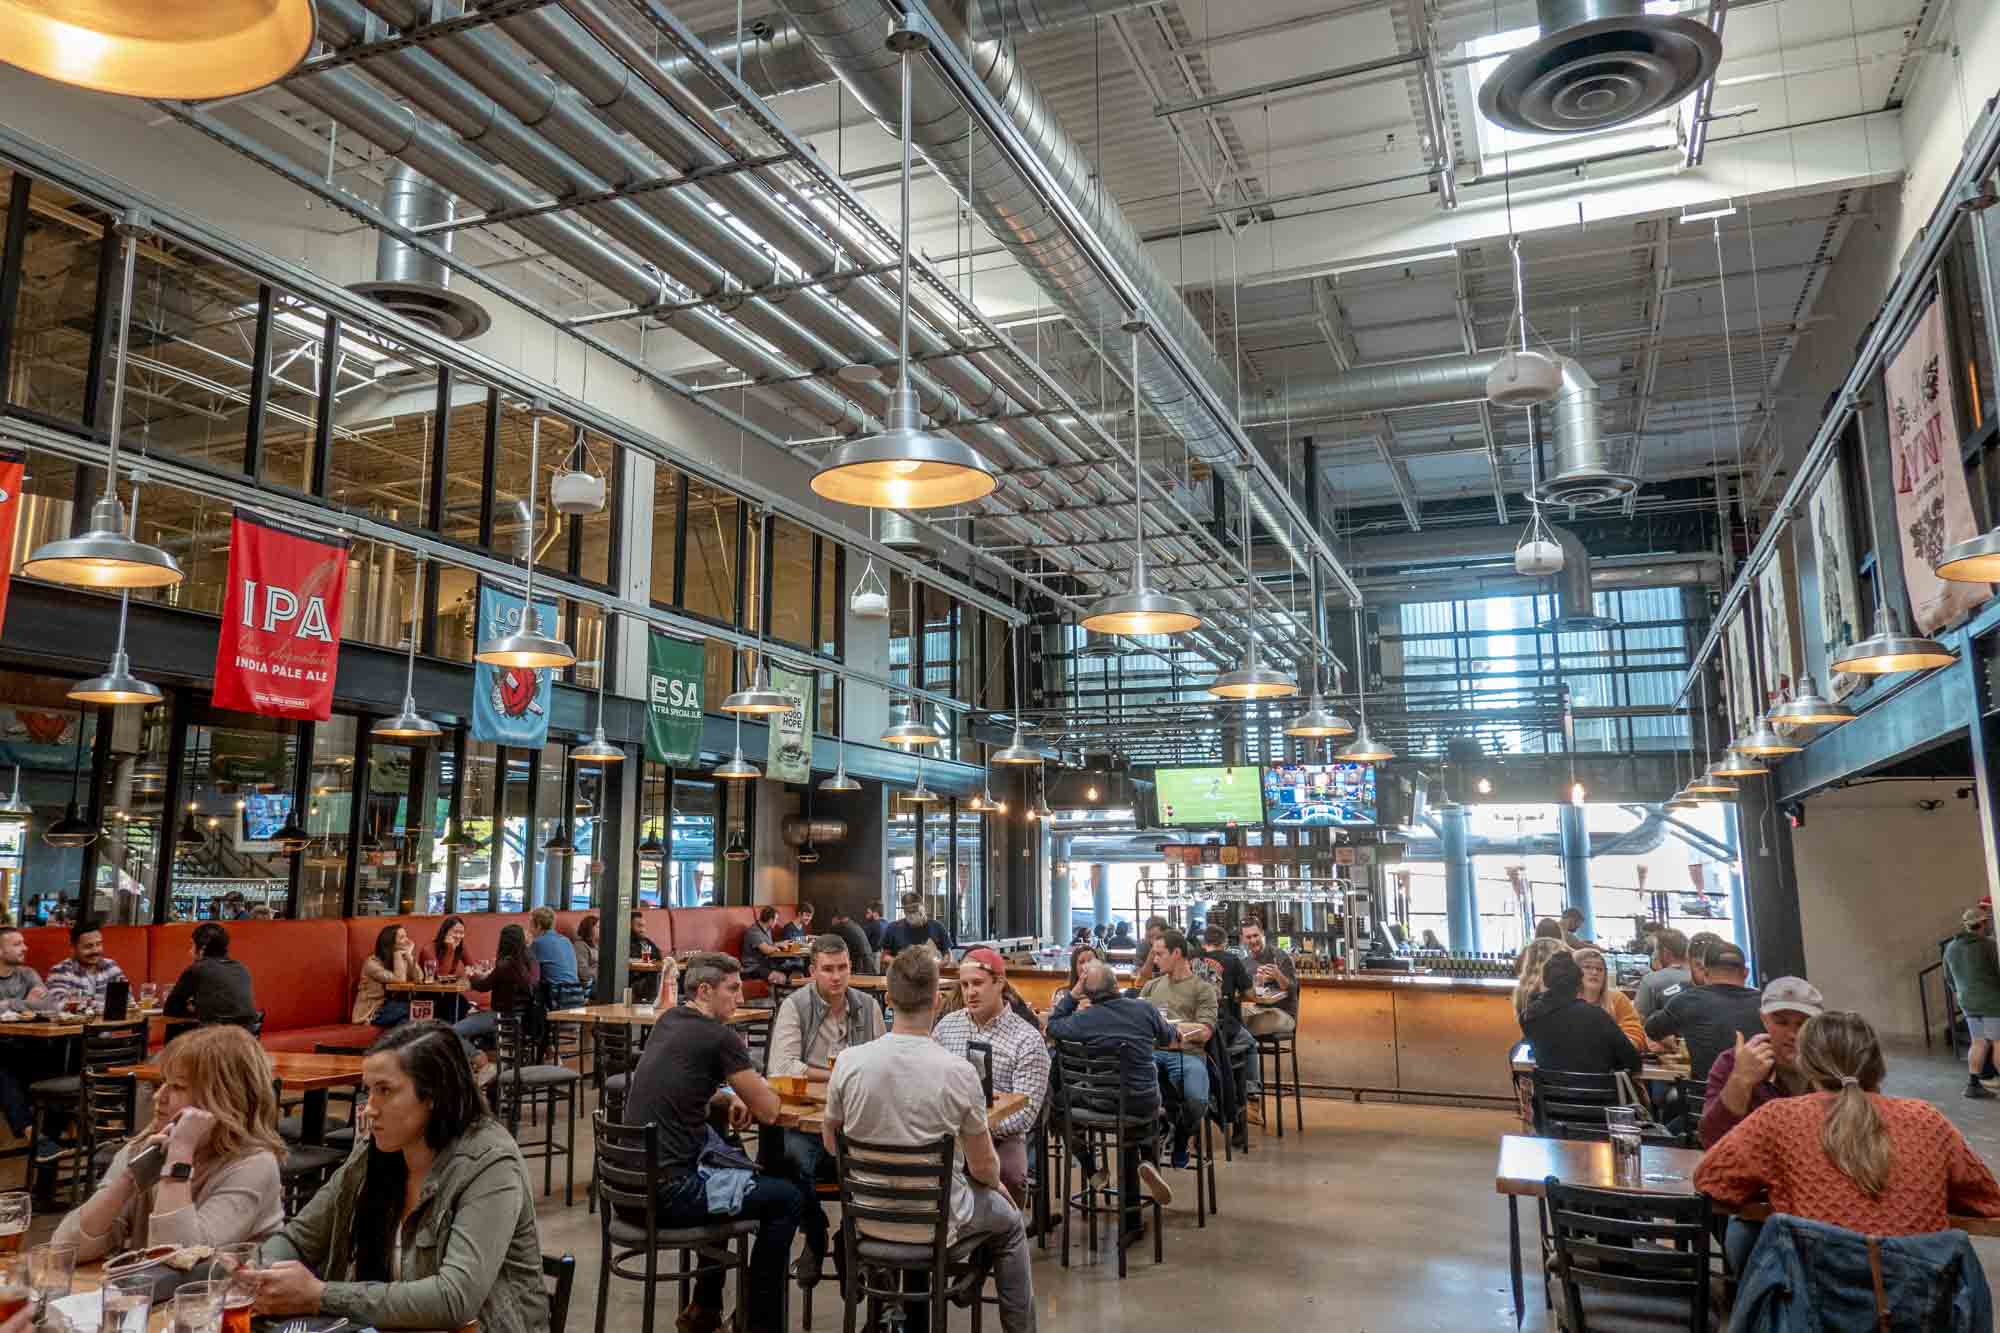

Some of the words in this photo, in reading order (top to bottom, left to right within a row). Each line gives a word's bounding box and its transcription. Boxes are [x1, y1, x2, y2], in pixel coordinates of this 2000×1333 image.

[241, 578, 335, 642] IPA
[235, 655, 268, 673] INDIA
[271, 664, 303, 680] PALE
[305, 670, 328, 683] ALE
[650, 674, 699, 709] ESA
[783, 717, 802, 729] HOPE
[412, 1007, 431, 1019] UP
